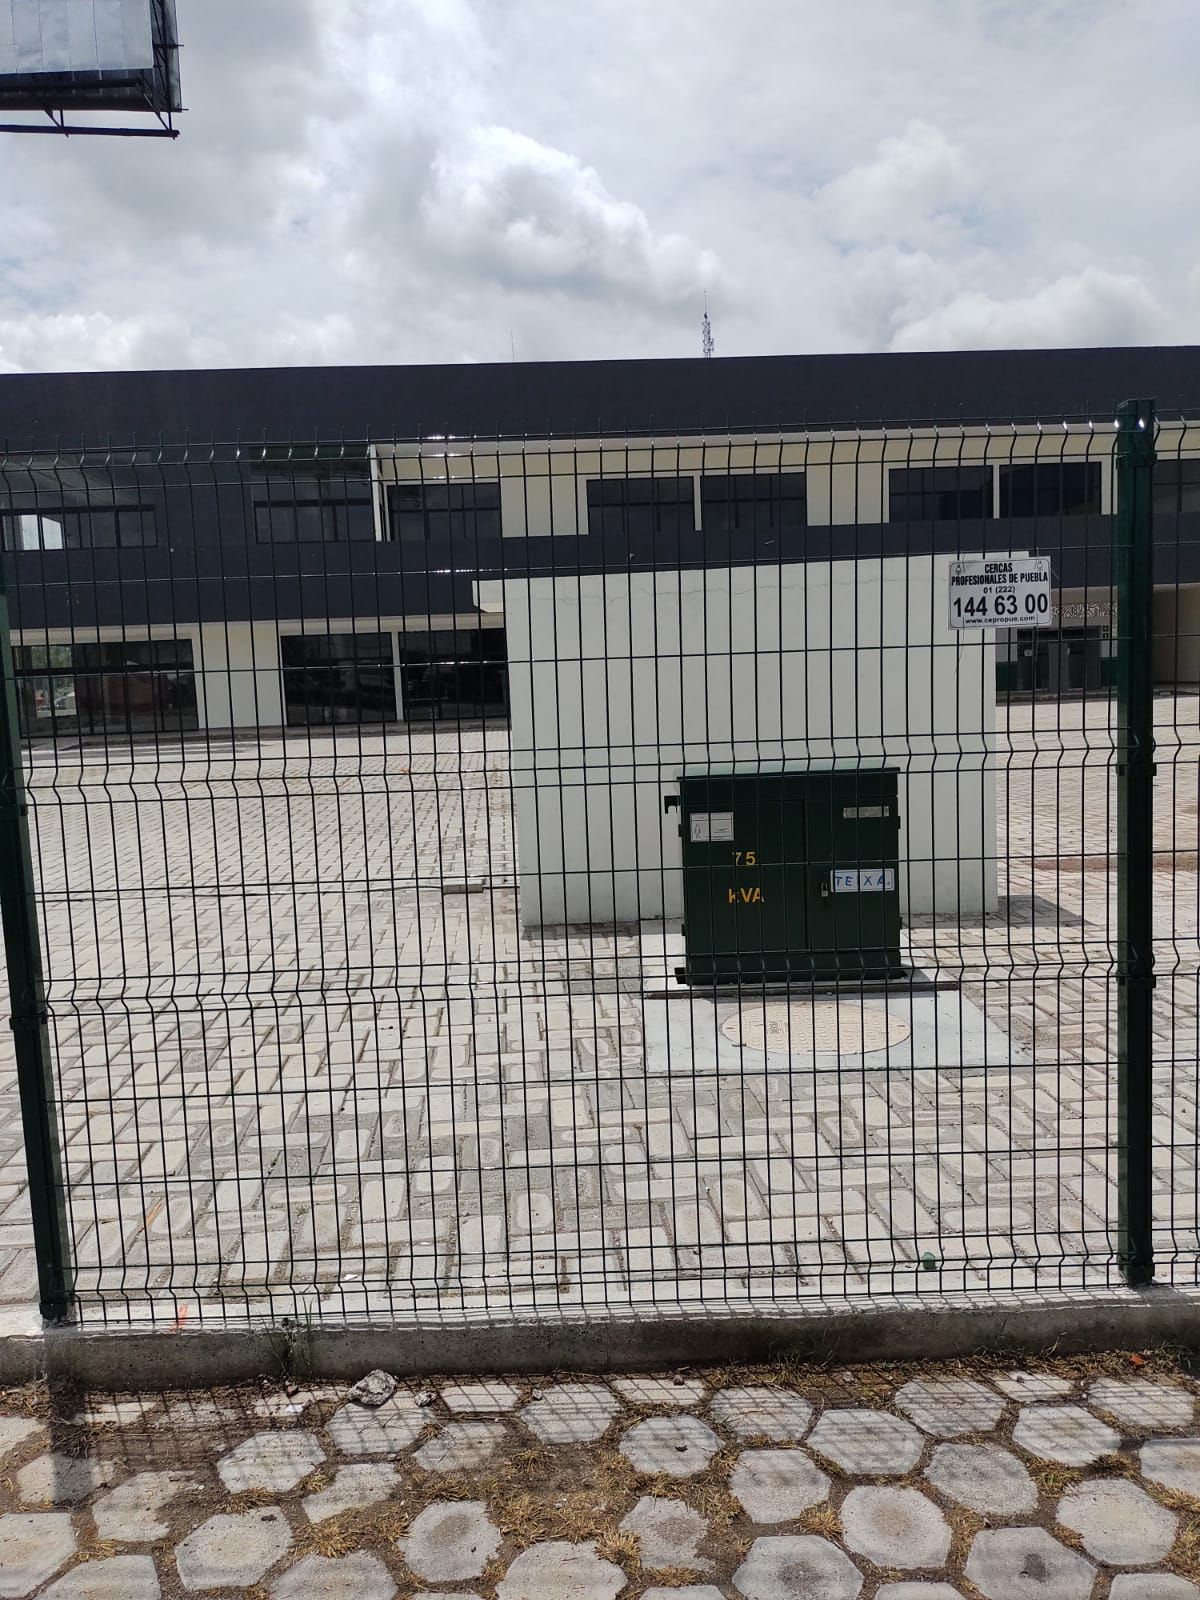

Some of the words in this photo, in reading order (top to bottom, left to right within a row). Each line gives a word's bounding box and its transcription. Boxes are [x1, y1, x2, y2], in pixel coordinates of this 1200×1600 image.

[984, 563, 1013, 574] CERCAS
[951, 574, 1007, 586] PROFESIONALES
[1009, 573, 1018, 583] DE
[1020, 571, 1048, 583] PUEBLA
[983, 586, 992, 594] 01
[995, 586, 1015, 594] (222)
[953, 596, 988, 617] 144
[994, 595, 1018, 615] 63
[1025, 593, 1048, 614] 00
[965, 616, 1035, 624] www.cepropue.com
[732, 851, 756, 866] 75
